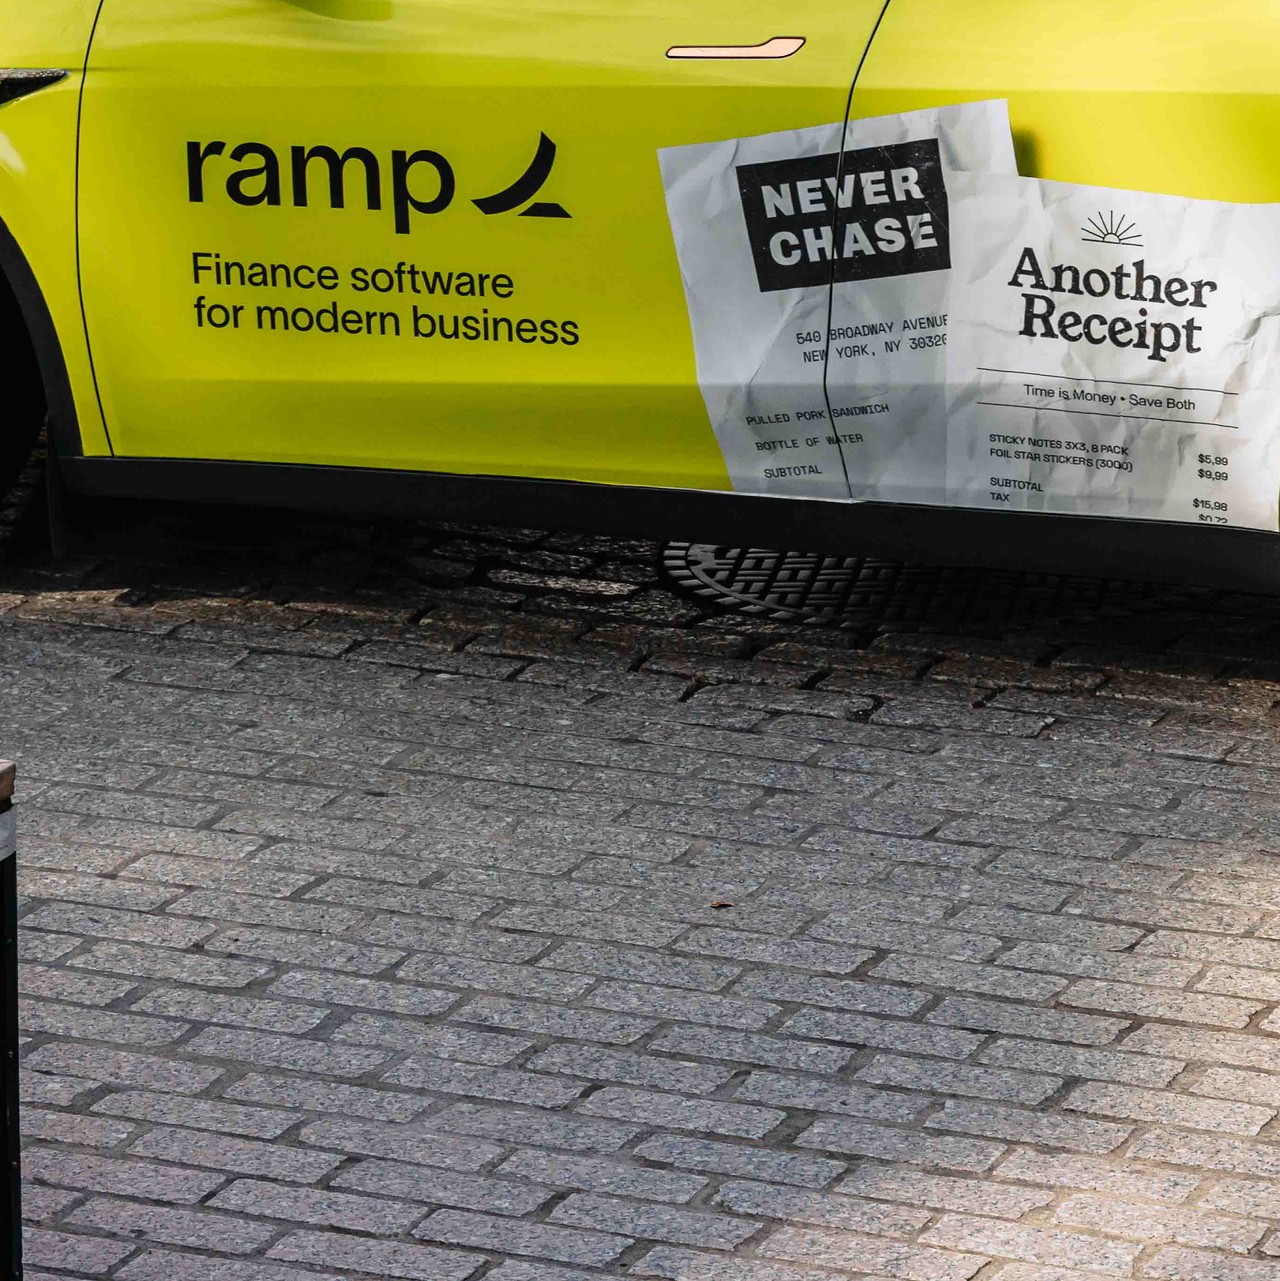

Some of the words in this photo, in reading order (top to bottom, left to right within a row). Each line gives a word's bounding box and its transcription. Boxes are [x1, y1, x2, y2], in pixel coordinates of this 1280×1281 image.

[186, 140, 456, 234] ramp
[761, 167, 924, 218] NEVER
[769, 213, 938, 266] CHASE
[192, 252, 339, 290] Finance
[351, 261, 514, 298] software
[1008, 247, 1218, 308] Another
[195, 296, 244, 328] for
[256, 301, 401, 336] modern
[412, 305, 580, 345] business
[1019, 293, 1202, 362] Receipt
[796, 331, 821, 344] 540
[830, 322, 894, 340] BROADWAY
[803, 349, 826, 363] NEW
[836, 344, 875, 358] YORK,
[885, 340, 901, 353] NY
[1024, 383, 1055, 398] Time
[1058, 386, 1068, 400] is
[1073, 390, 1116, 405] Money
[1128, 395, 1164, 407] Save
[1167, 398, 1196, 410] Both
[746, 413, 790, 425] PULLED
[796, 410, 826, 421] PORK
[832, 403, 890, 418] SANDWICH
[755, 439, 799, 451] BOTTLE
[806, 437, 820, 447] OF
[826, 433, 863, 445] WATER
[990, 434, 1026, 445] STICKY
[1028, 438, 1062, 449] NOTES
[1065, 441, 1090, 453] 3X3,
[1091, 444, 1099, 453] 8
[1101, 445, 1129, 456] PACK
[764, 465, 822, 479] SUBTOTAL
[990, 448, 1012, 458] FOIL
[1014, 451, 1041, 462] STAR
[1043, 454, 1093, 467] STICKERS
[1096, 459, 1133, 472] (3000)
[990, 477, 1044, 492] SUBTOTAL
[990, 492, 1010, 502] TAX
